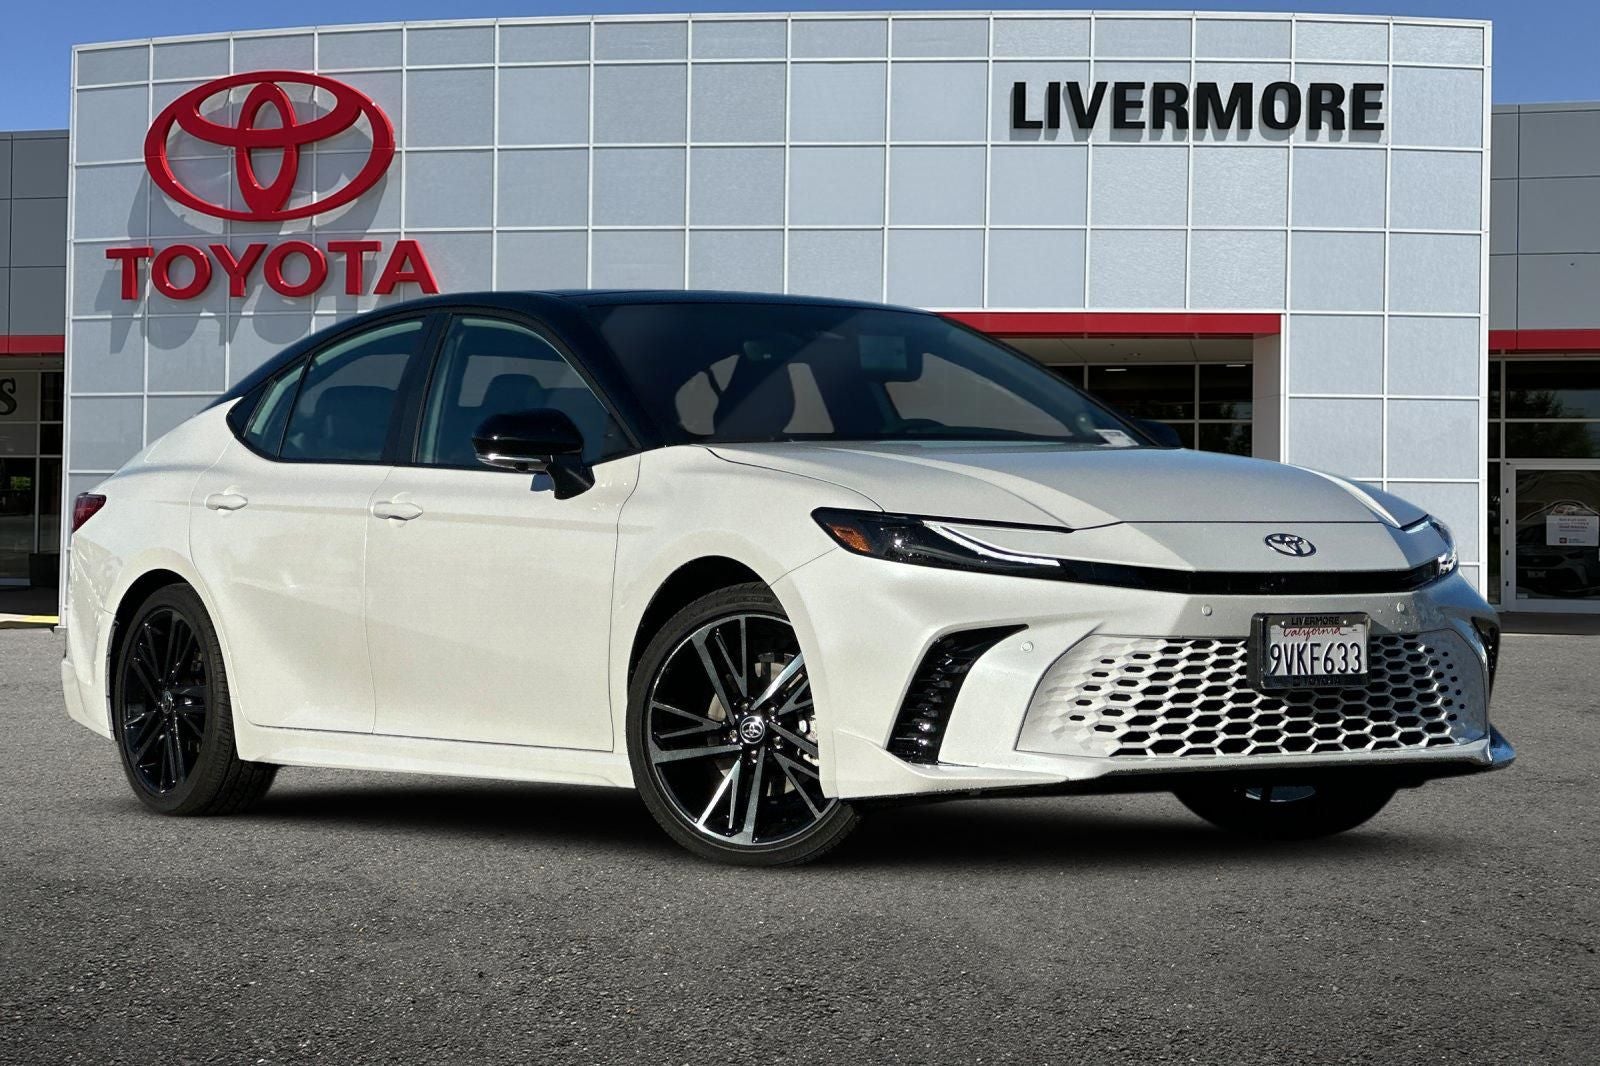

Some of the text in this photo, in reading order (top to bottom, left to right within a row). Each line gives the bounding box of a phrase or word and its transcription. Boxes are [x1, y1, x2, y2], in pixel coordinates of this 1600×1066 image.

[1013, 81, 1384, 130] LIVERMORE
[105, 240, 440, 300] TOYOTA
[1283, 626, 1347, 641] California
[1291, 616, 1340, 626] LIVERMORE
[1270, 642, 1361, 675] 9VKF633
